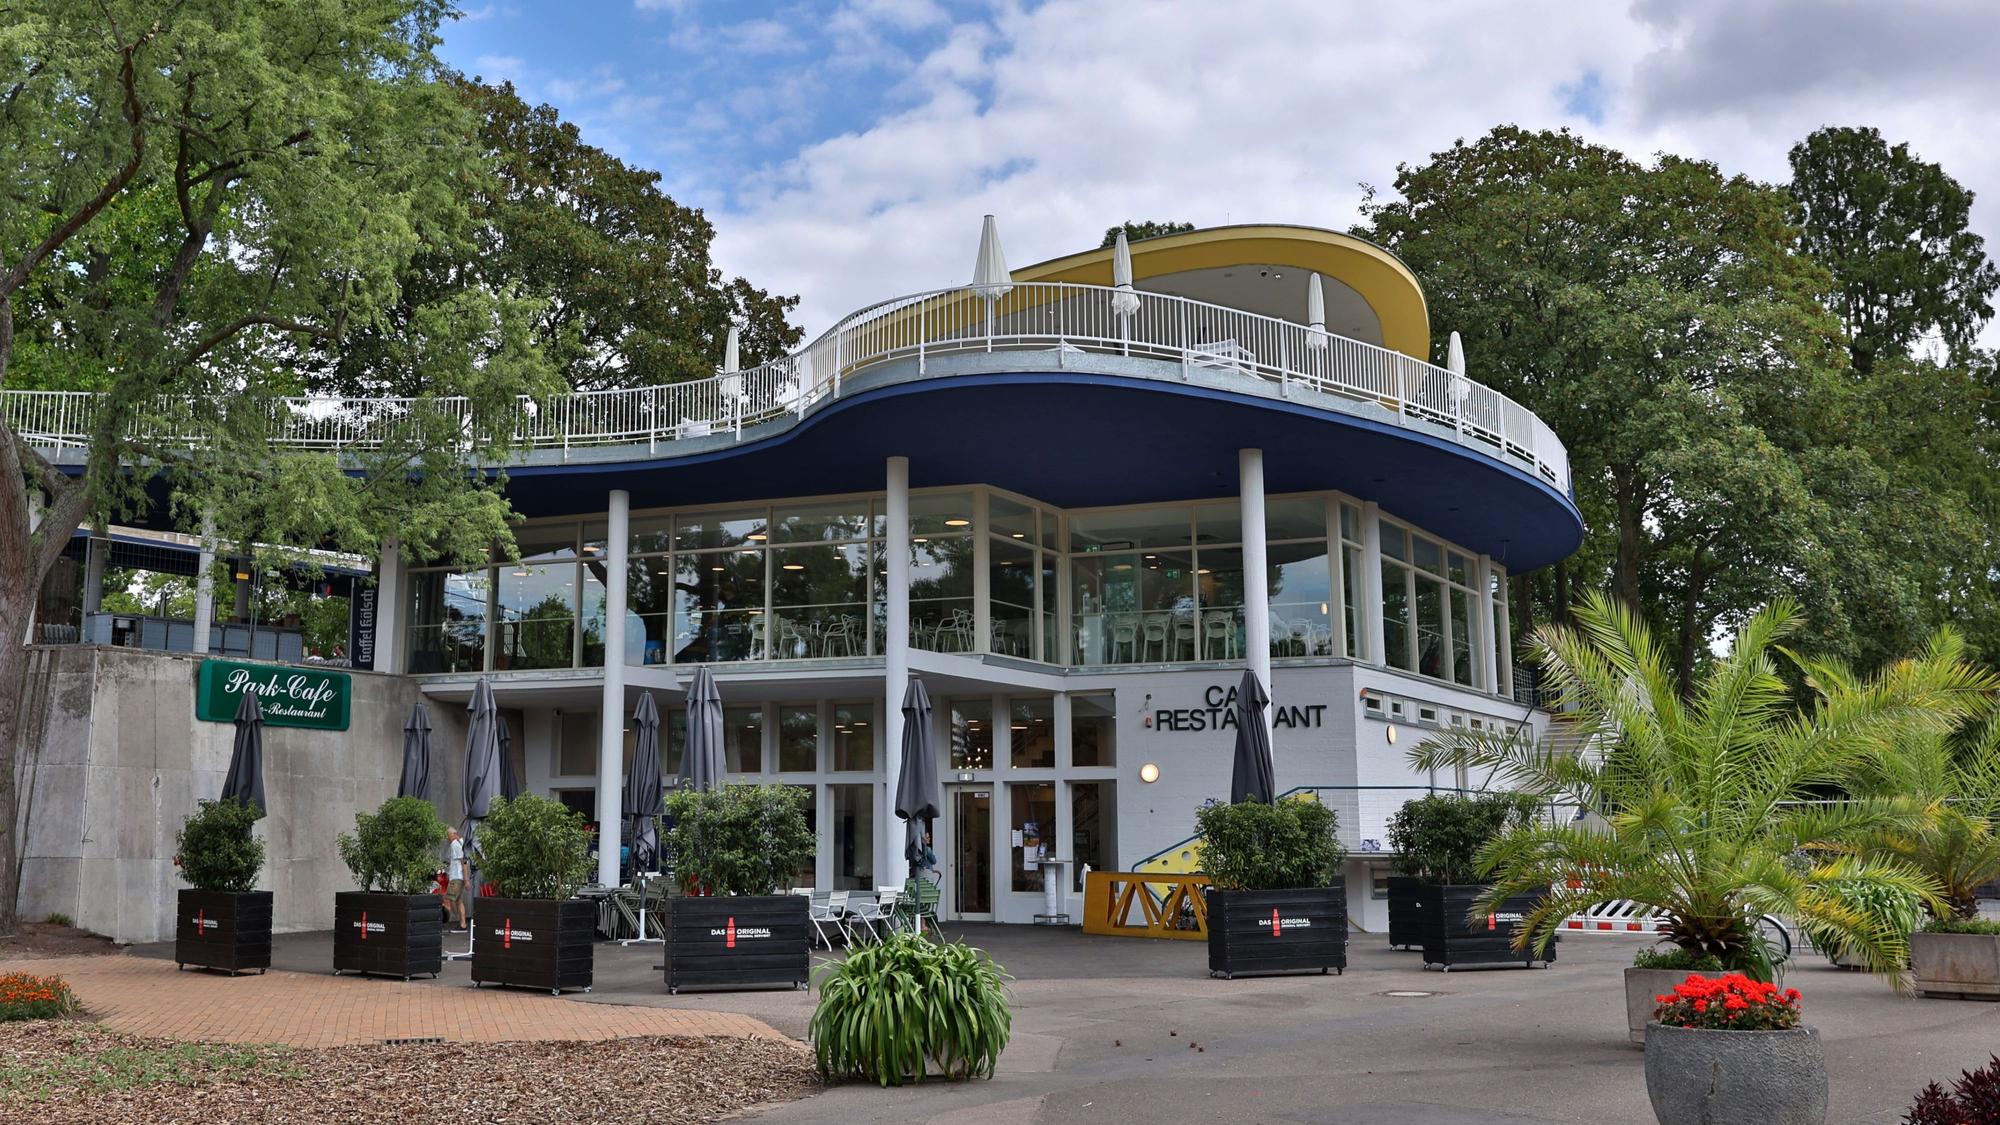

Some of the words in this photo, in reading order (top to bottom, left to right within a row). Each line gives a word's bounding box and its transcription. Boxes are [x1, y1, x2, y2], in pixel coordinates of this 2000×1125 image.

[224, 668, 337, 710] Park-Cafe
[1156, 705, 1327, 731] RESTAANT
[1280, 917, 1311, 925] ORIGINAL
